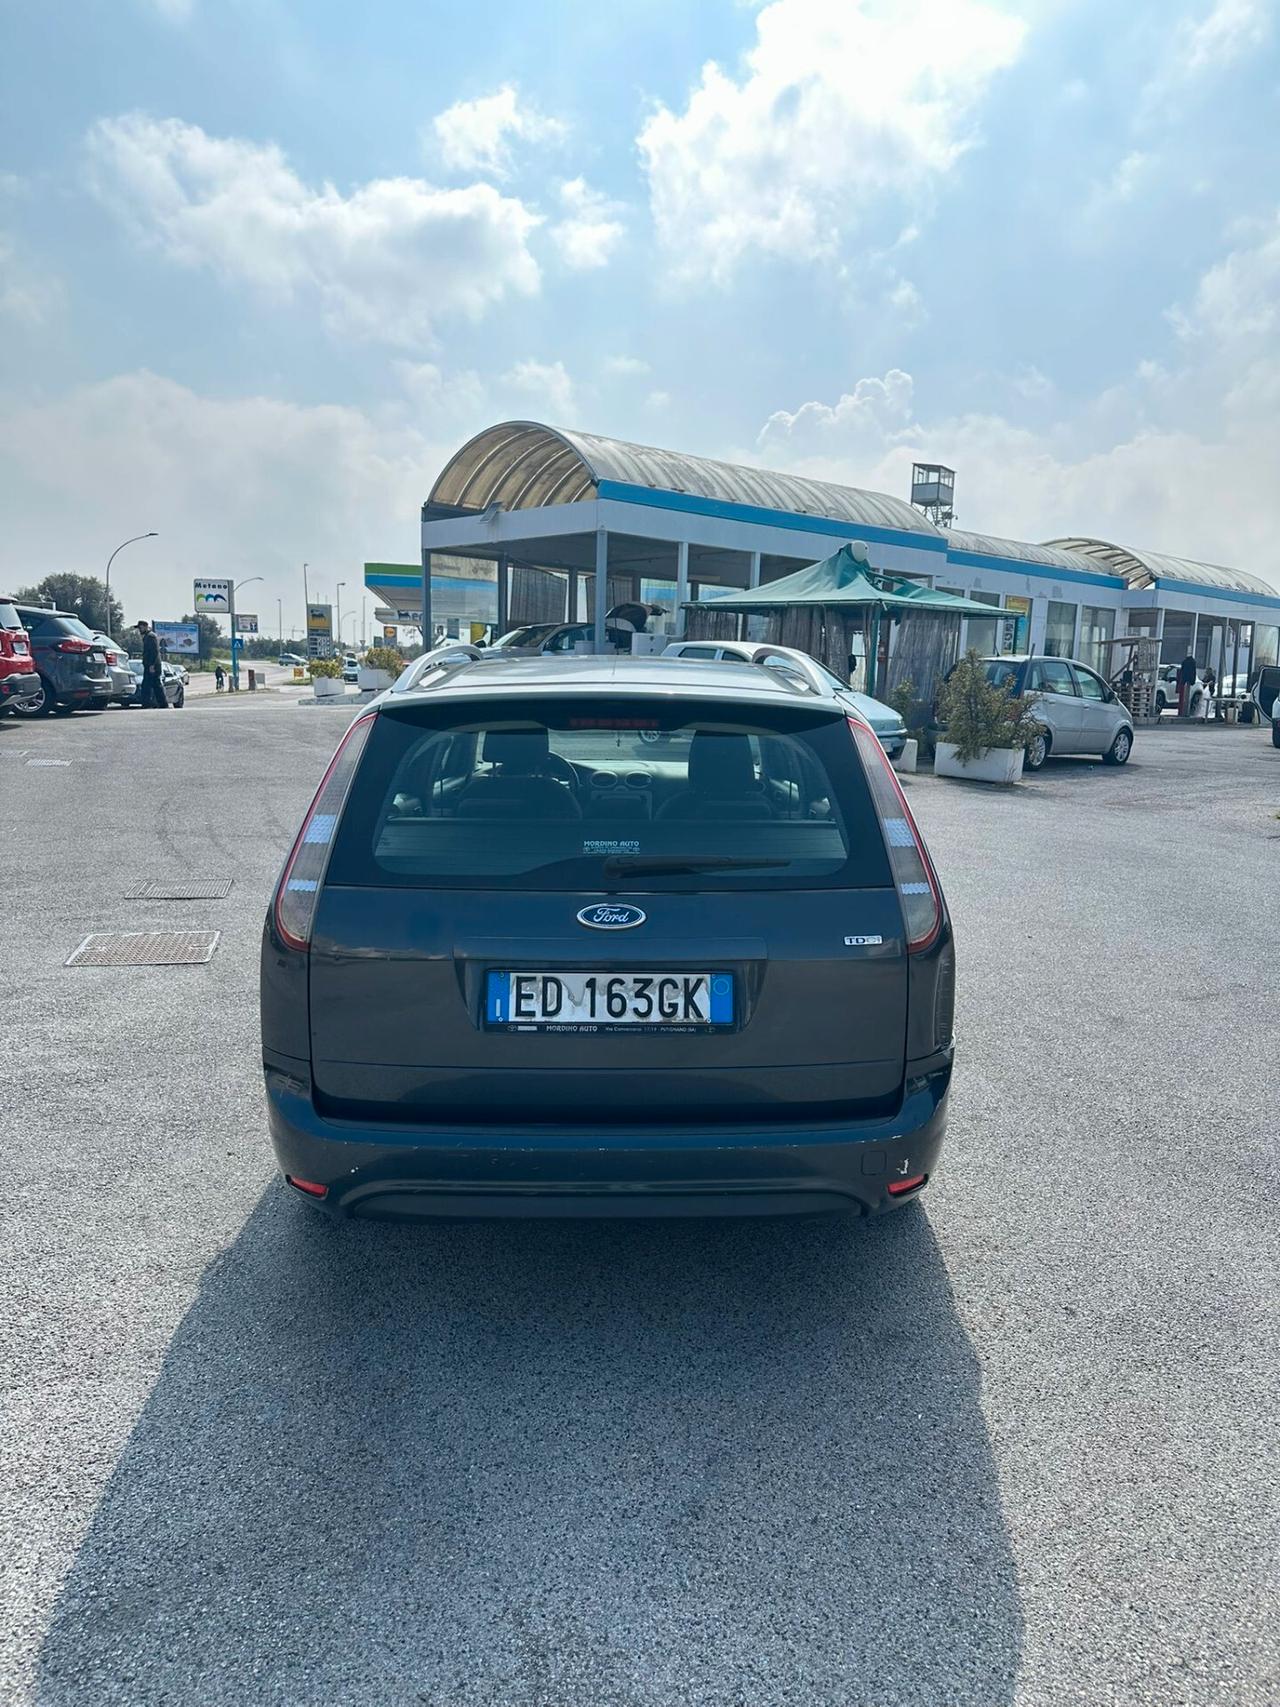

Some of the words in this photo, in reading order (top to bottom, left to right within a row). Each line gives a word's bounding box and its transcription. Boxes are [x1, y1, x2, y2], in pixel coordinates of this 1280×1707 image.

[195, 582, 228, 590] Metano
[583, 840, 618, 848] MORDINO
[593, 907, 629, 923] Ford
[515, 975, 563, 1018] ED
[585, 976, 705, 1019] 163GK
